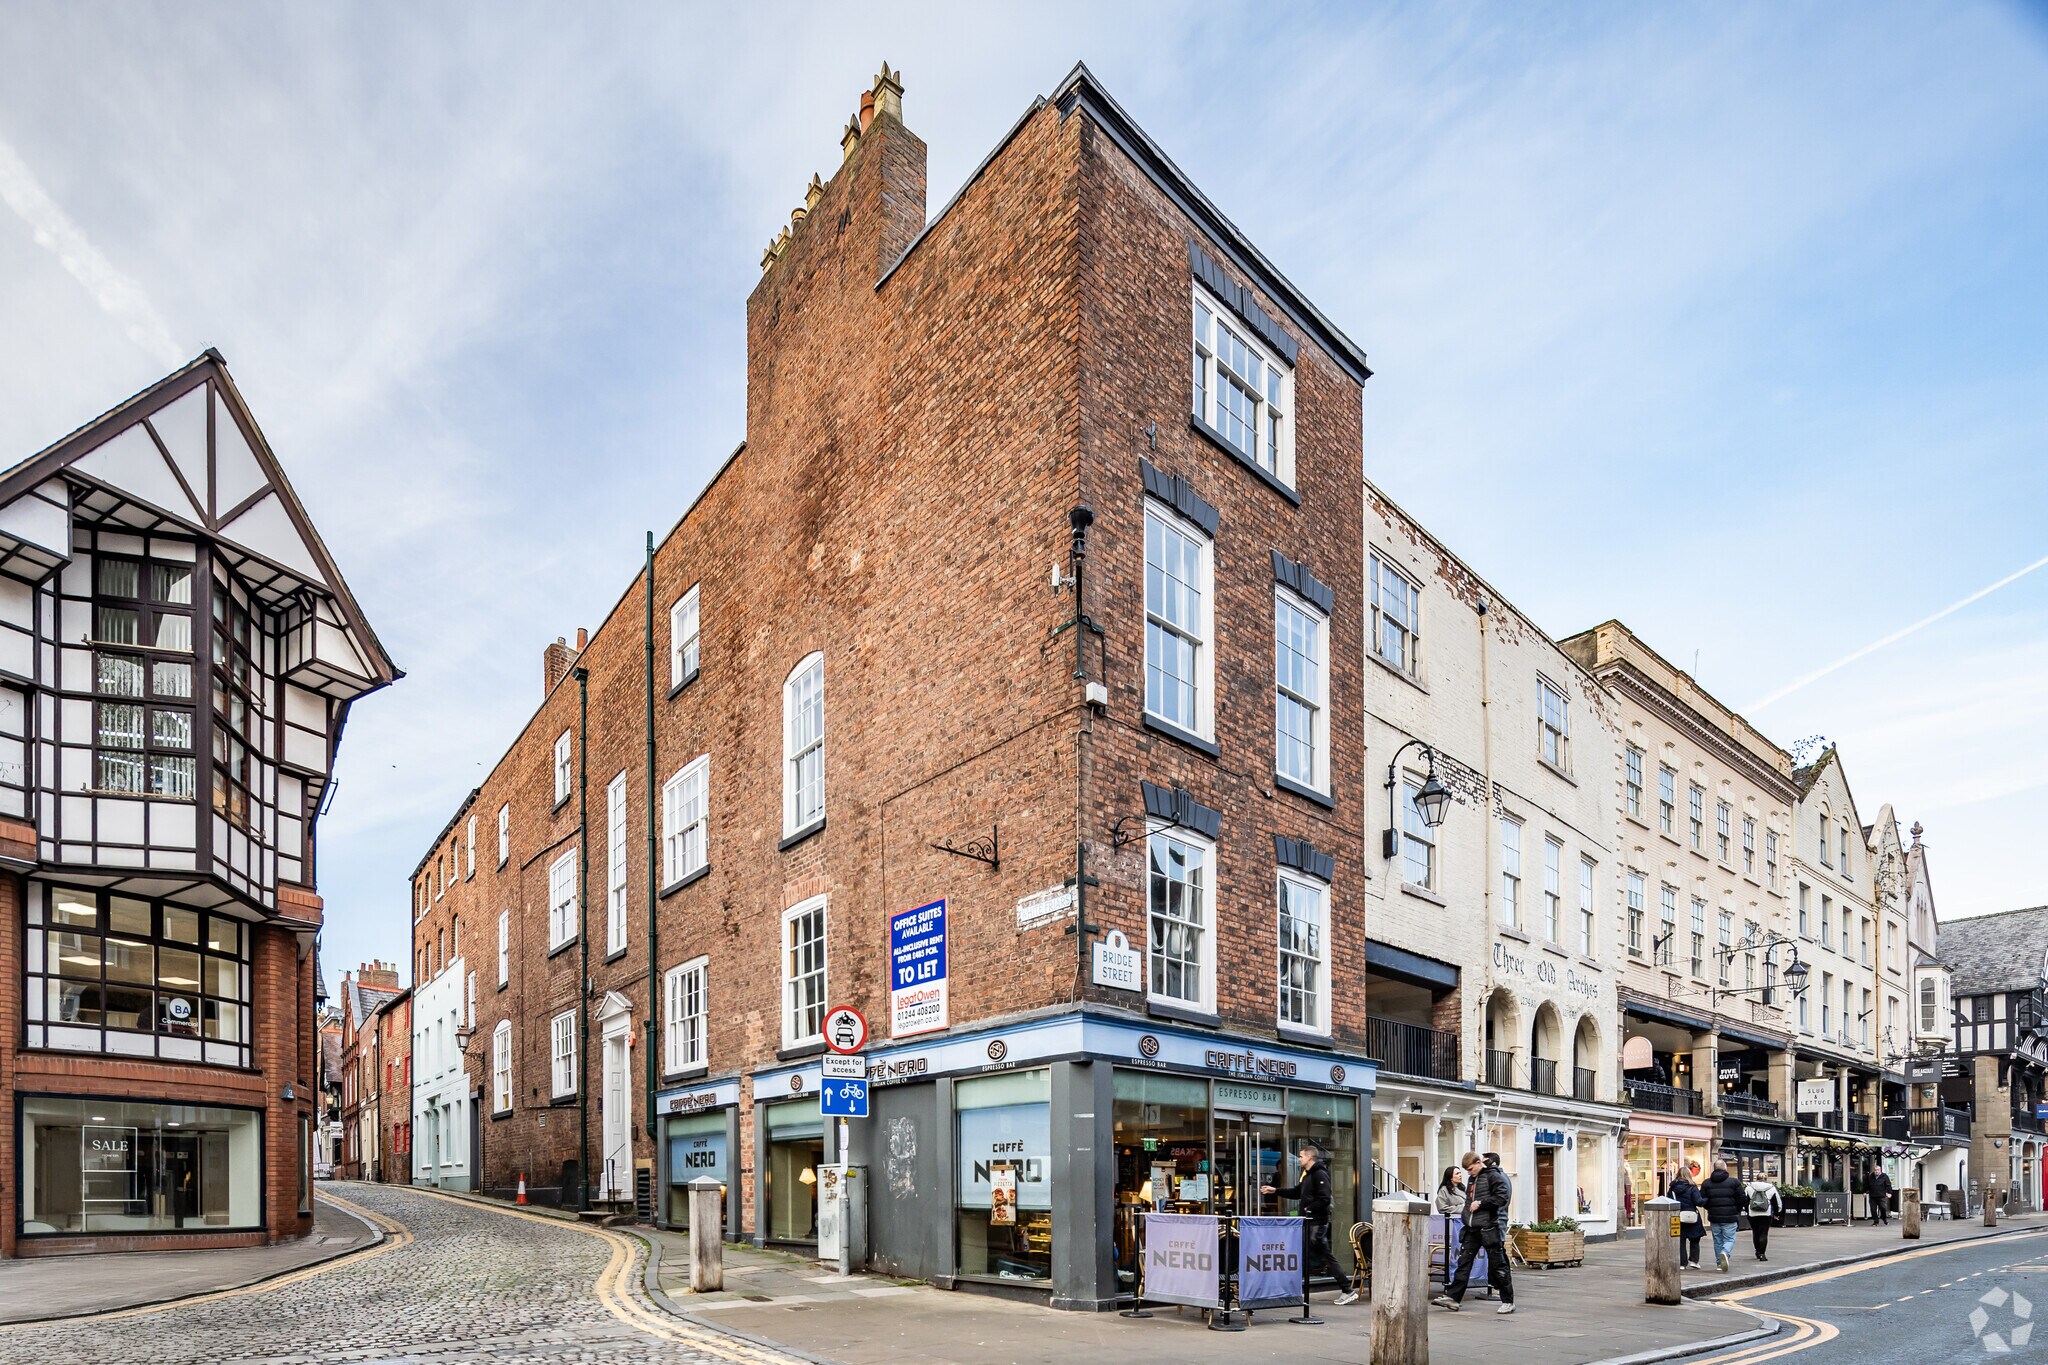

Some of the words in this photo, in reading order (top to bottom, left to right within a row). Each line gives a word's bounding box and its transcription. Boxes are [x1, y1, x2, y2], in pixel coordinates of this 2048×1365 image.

[894, 914, 917, 931] OFFICE
[918, 906, 942, 923] SUITES
[902, 920, 934, 940] AVAILABLE
[894, 939, 928, 956] ALL-INCLUSIVE
[930, 934, 943, 946] RENT
[898, 952, 912, 964] FROM
[1102, 950, 1132, 968] BRIDGE
[898, 966, 914, 984] TO
[918, 959, 938, 980] LET
[1102, 966, 1132, 982] STREET
[1493, 942, 1525, 976] Three
[1538, 960, 1556, 984] Old
[1567, 969, 1598, 1000] Arches
[175, 1004, 190, 1014] BA
[898, 1008, 915, 1020] 01244
[162, 1018, 198, 1028] Commercial
[826, 1058, 850, 1066] Except
[888, 1058, 928, 1078] NERO
[982, 1062, 1005, 1072] ESPRESSO
[1006, 1062, 1016, 1070] BAR
[1132, 1058, 1156, 1067] ESPRESSO
[1256, 1057, 1297, 1078] NERO
[1219, 1087, 1259, 1100] ESPRESSO
[1262, 1093, 1276, 1102] BAR
[1742, 1126, 1756, 1138] FIVE
[1756, 1128, 1771, 1140] GUYS
[92, 1140, 128, 1152] SALE
[694, 1138, 708, 1148] CAFFÈ
[992, 1139, 1024, 1152] CAFFÈ
[686, 1150, 716, 1168] NERO
[974, 1158, 1042, 1183] NRO
[1168, 1240, 1196, 1249] CAFFÈ
[1262, 1242, 1286, 1250] CAFFÈ
[1152, 1250, 1212, 1272] NERO
[1246, 1254, 1298, 1272] NERO
